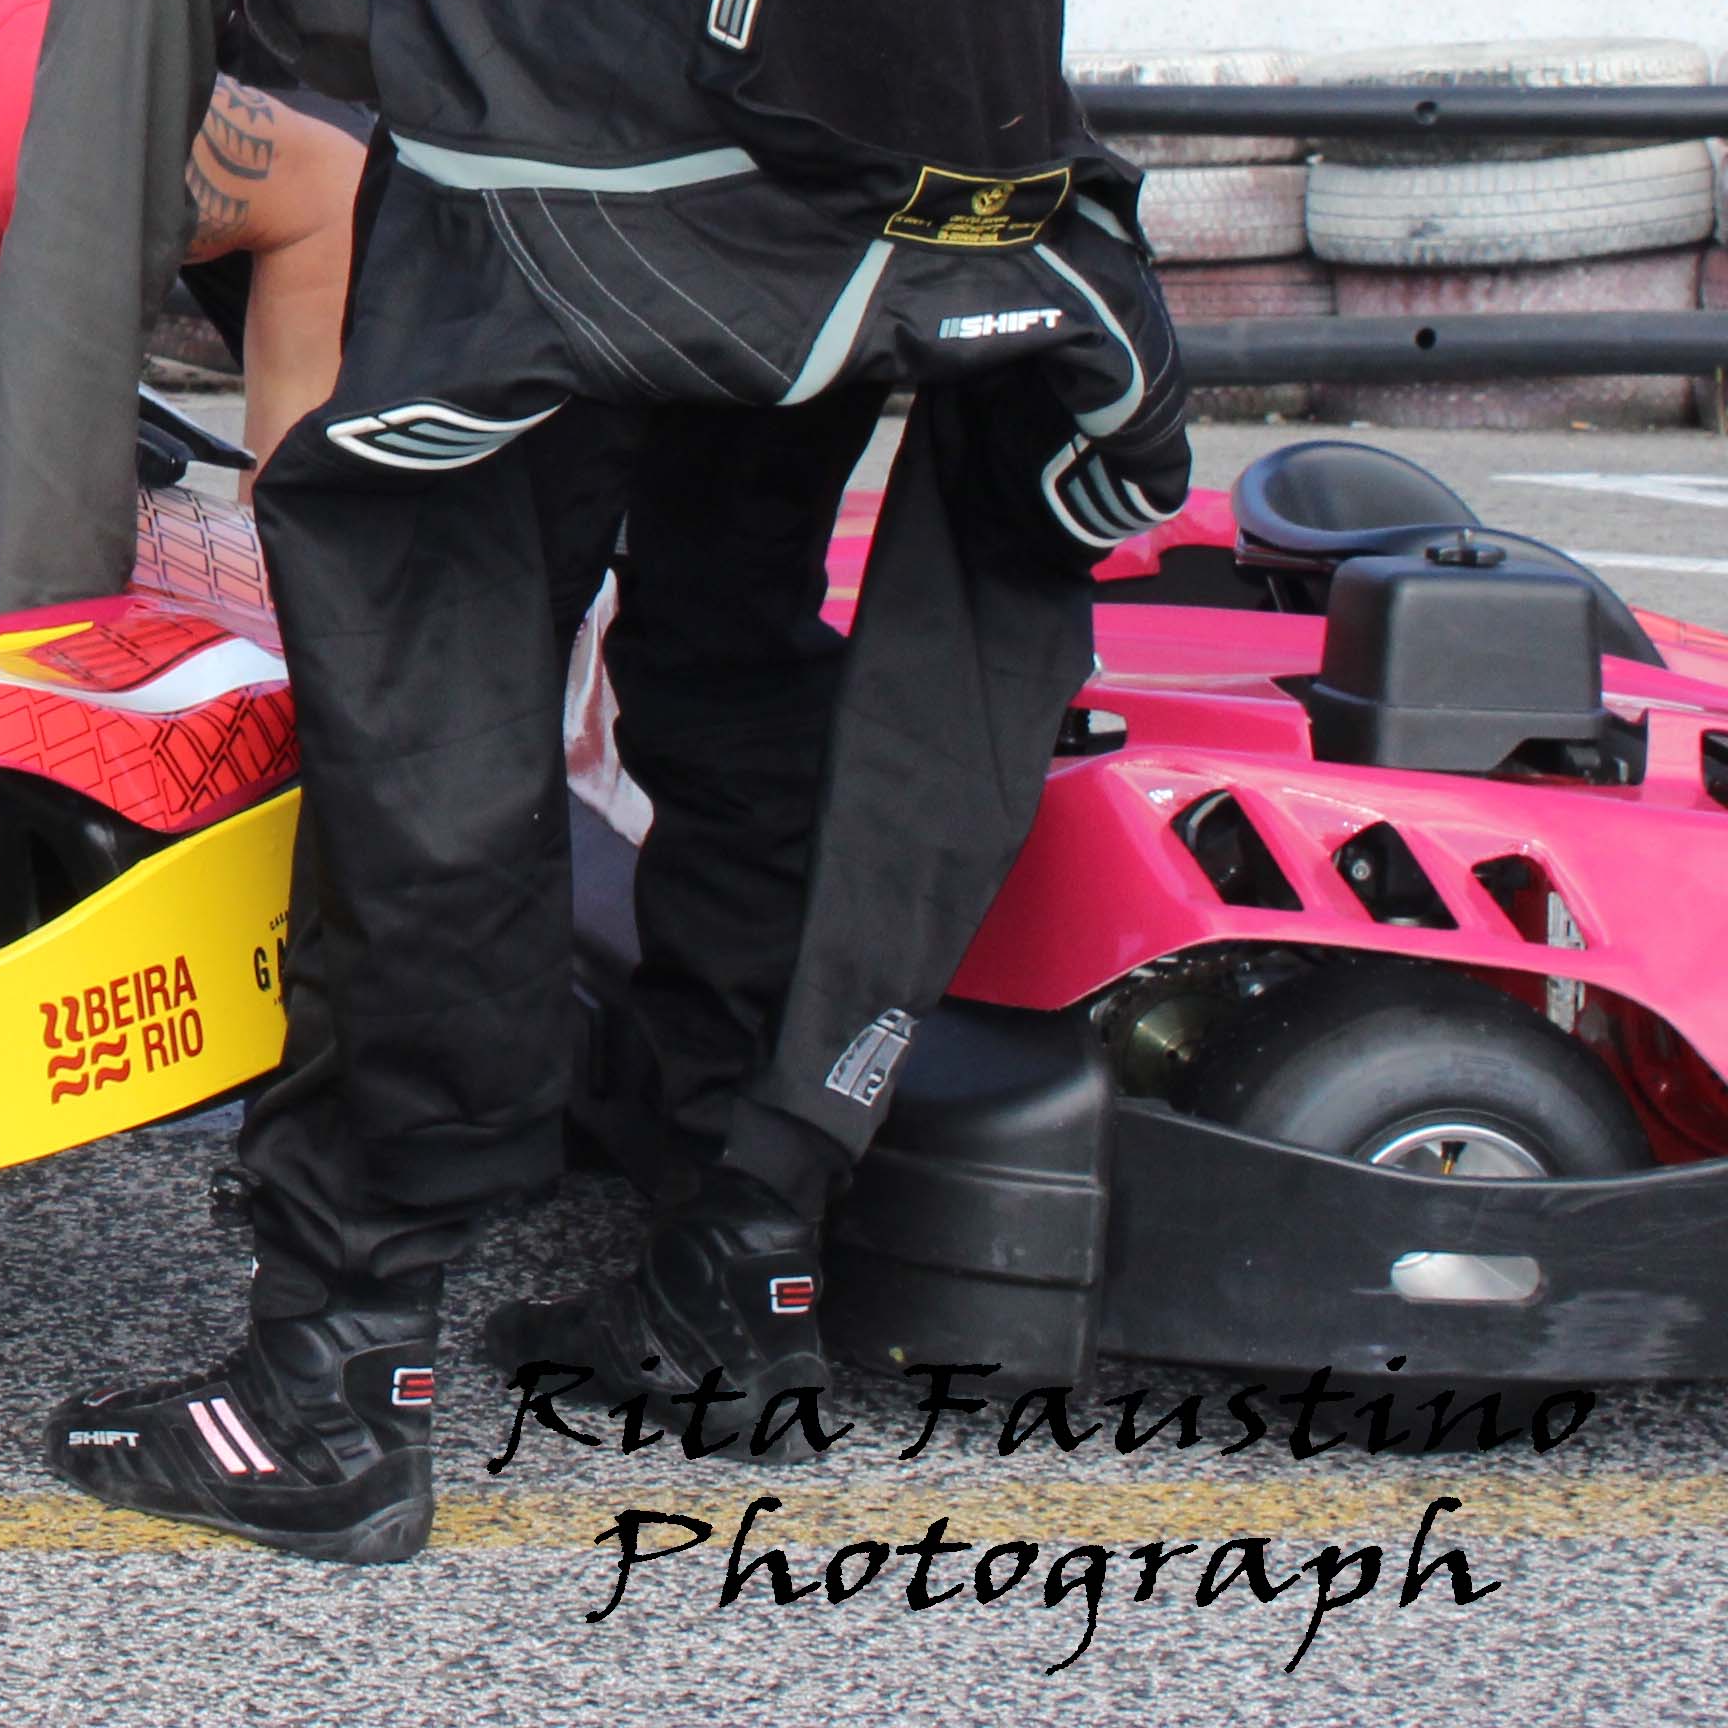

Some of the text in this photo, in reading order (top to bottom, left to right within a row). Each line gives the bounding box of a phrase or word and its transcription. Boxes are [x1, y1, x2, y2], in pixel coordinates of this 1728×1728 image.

[959, 308, 1062, 339] SHIFT
[84, 956, 197, 1041] BEIRA
[142, 1007, 204, 1073] RIO
[68, 1430, 140, 1447] SHIFT
